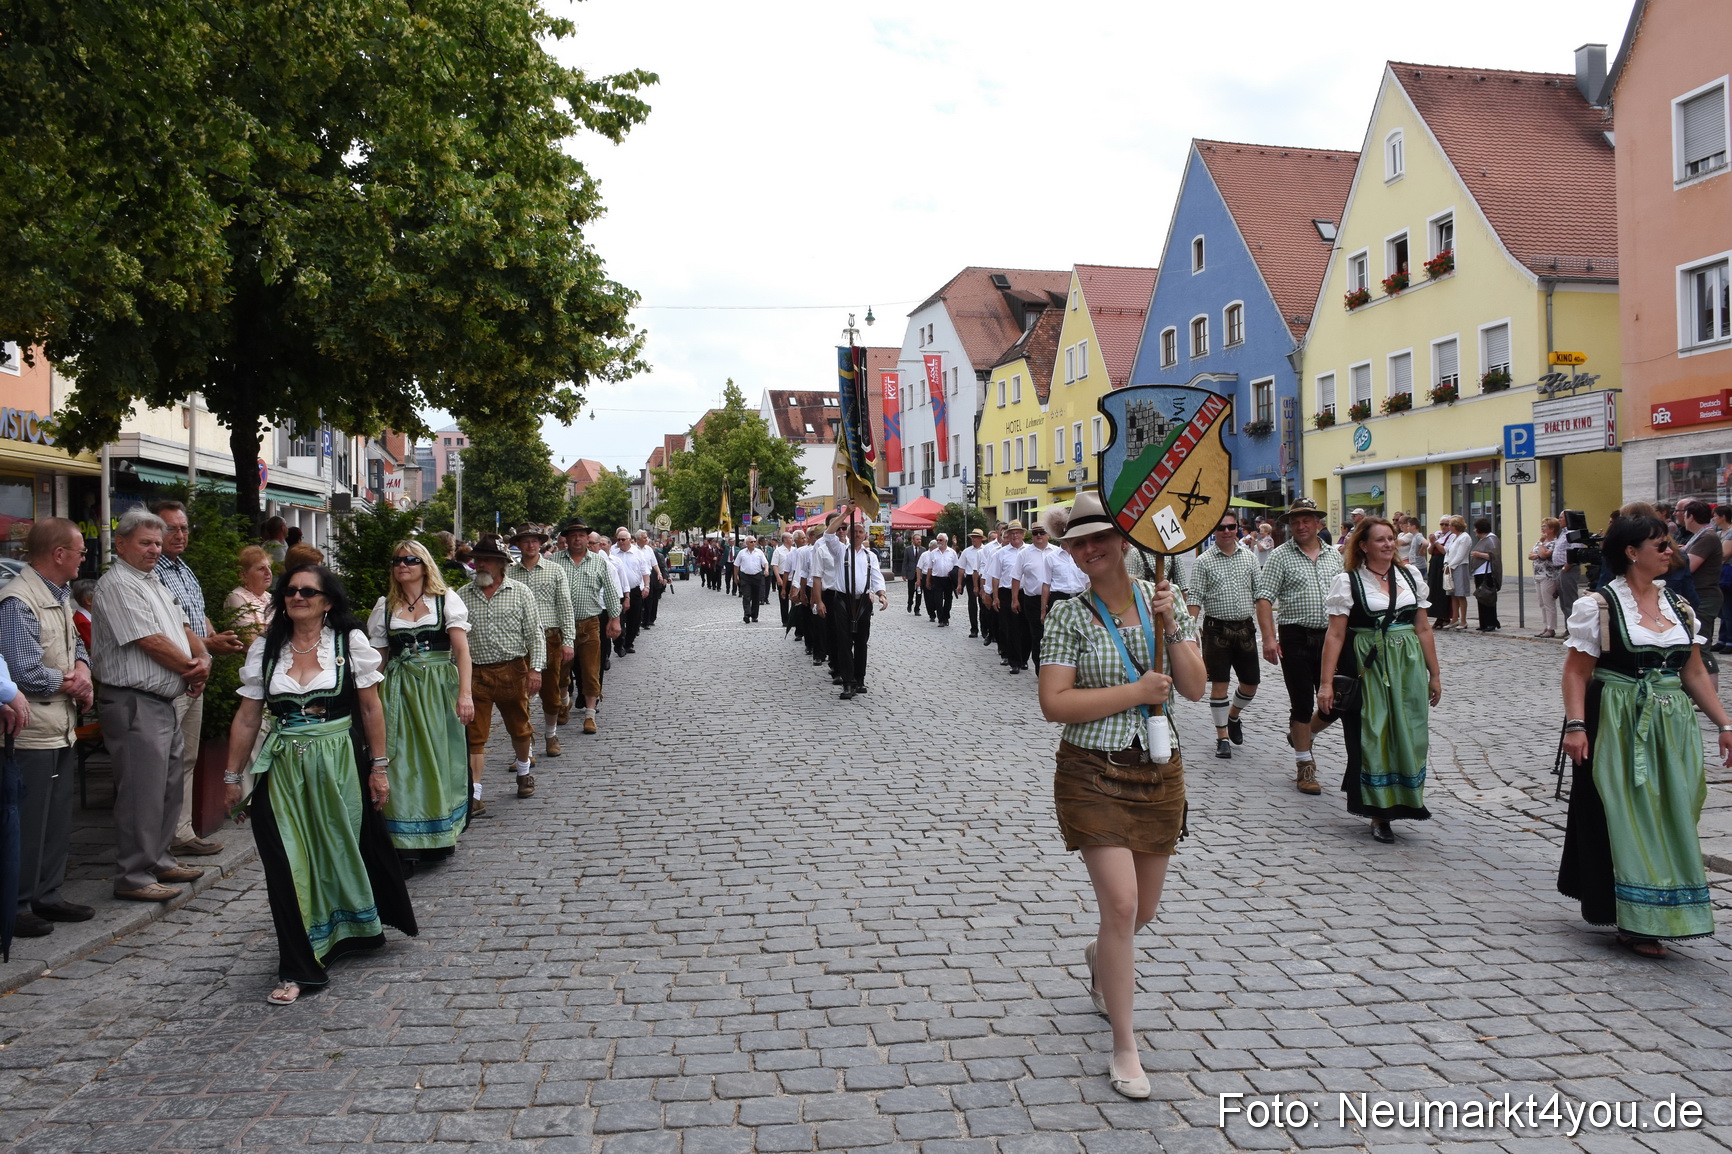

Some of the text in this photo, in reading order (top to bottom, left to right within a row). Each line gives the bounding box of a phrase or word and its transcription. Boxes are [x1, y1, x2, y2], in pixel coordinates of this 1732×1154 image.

[1556, 353, 1572, 362] KINO
[1006, 419, 1022, 434] HOTEL
[1544, 416, 1592, 434] RIALTO KINO
[1607, 392, 1615, 447] KINO
[1652, 411, 1671, 425] DER
[324, 433, 329, 452] P
[1510, 428, 1528, 455] P
[1076, 444, 1081, 460] P
[1121, 394, 1225, 521] WOLFSTEIN
[1160, 518, 1181, 541] 14
